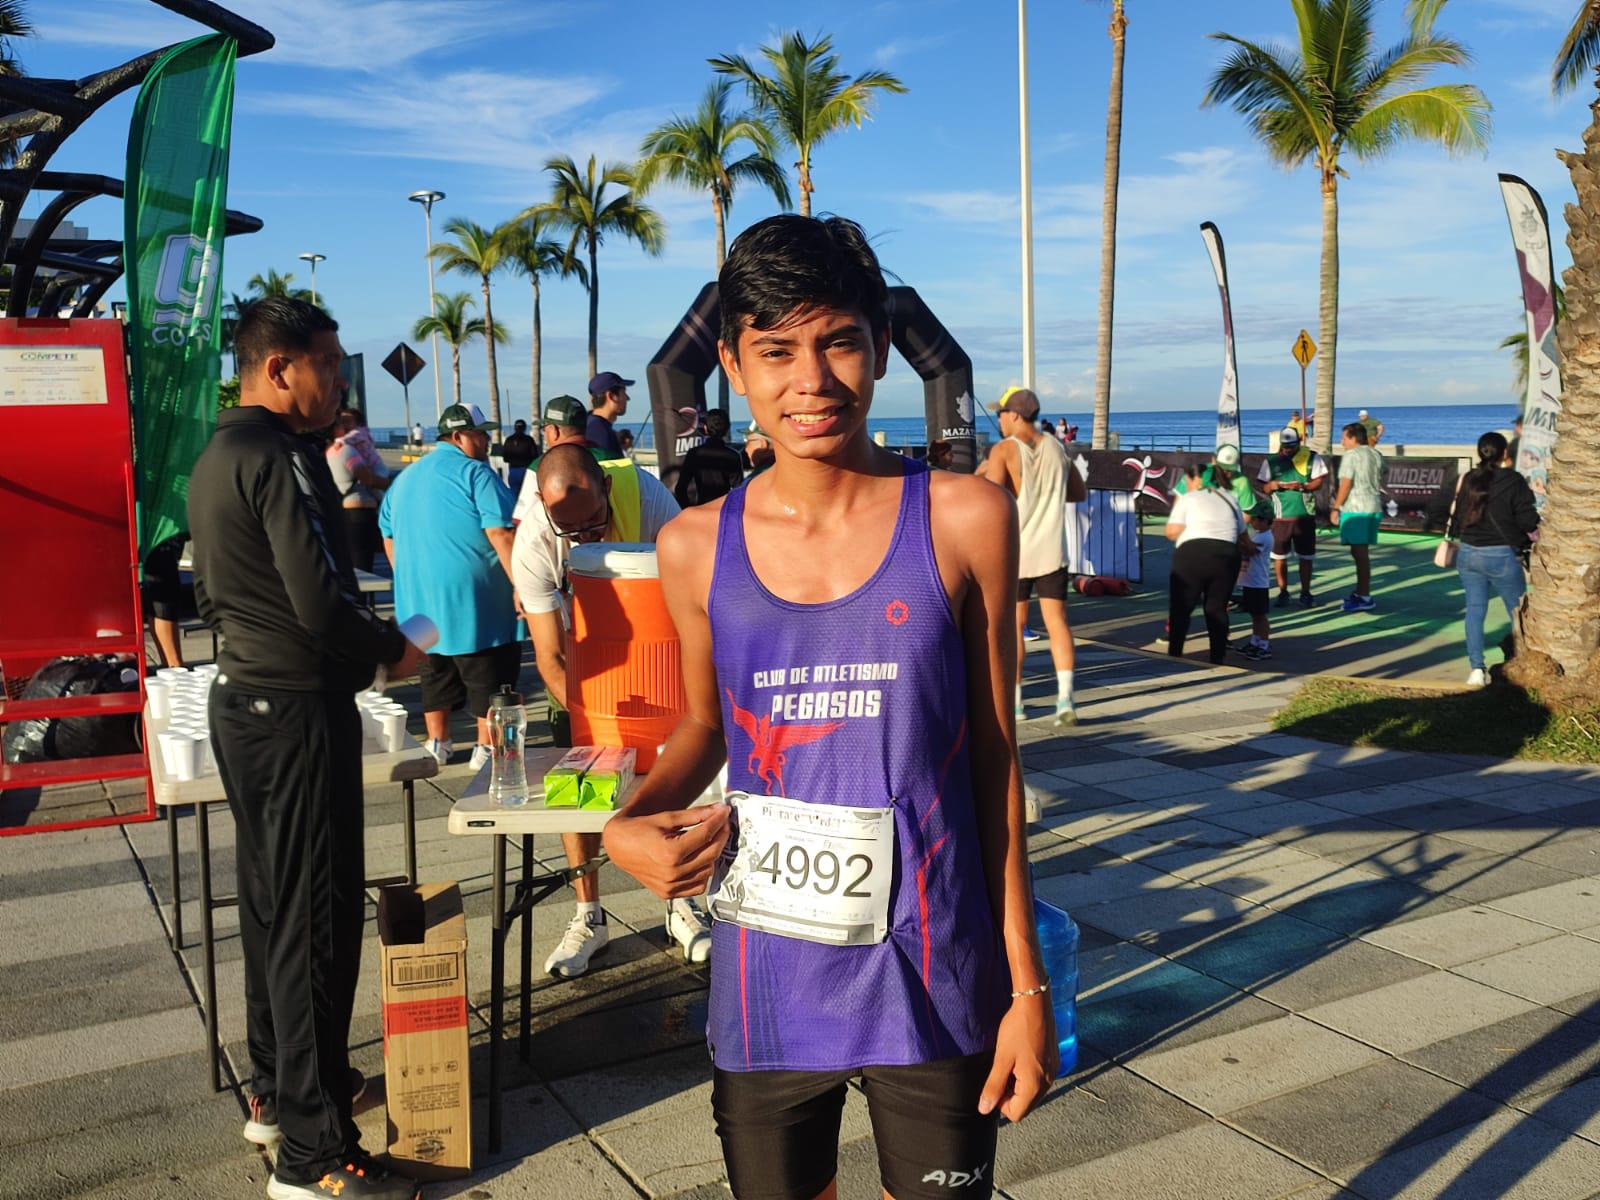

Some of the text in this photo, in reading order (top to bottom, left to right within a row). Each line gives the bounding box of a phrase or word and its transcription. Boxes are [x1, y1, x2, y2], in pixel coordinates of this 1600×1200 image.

[20, 352, 78, 360] COMPETE
[1387, 466, 1444, 484] IMDEM
[753, 662, 899, 689] CLUB DE ATLETISMO
[770, 690, 882, 722] PEGASOS
[756, 842, 873, 898] 4992
[921, 1162, 988, 1188] ADX
